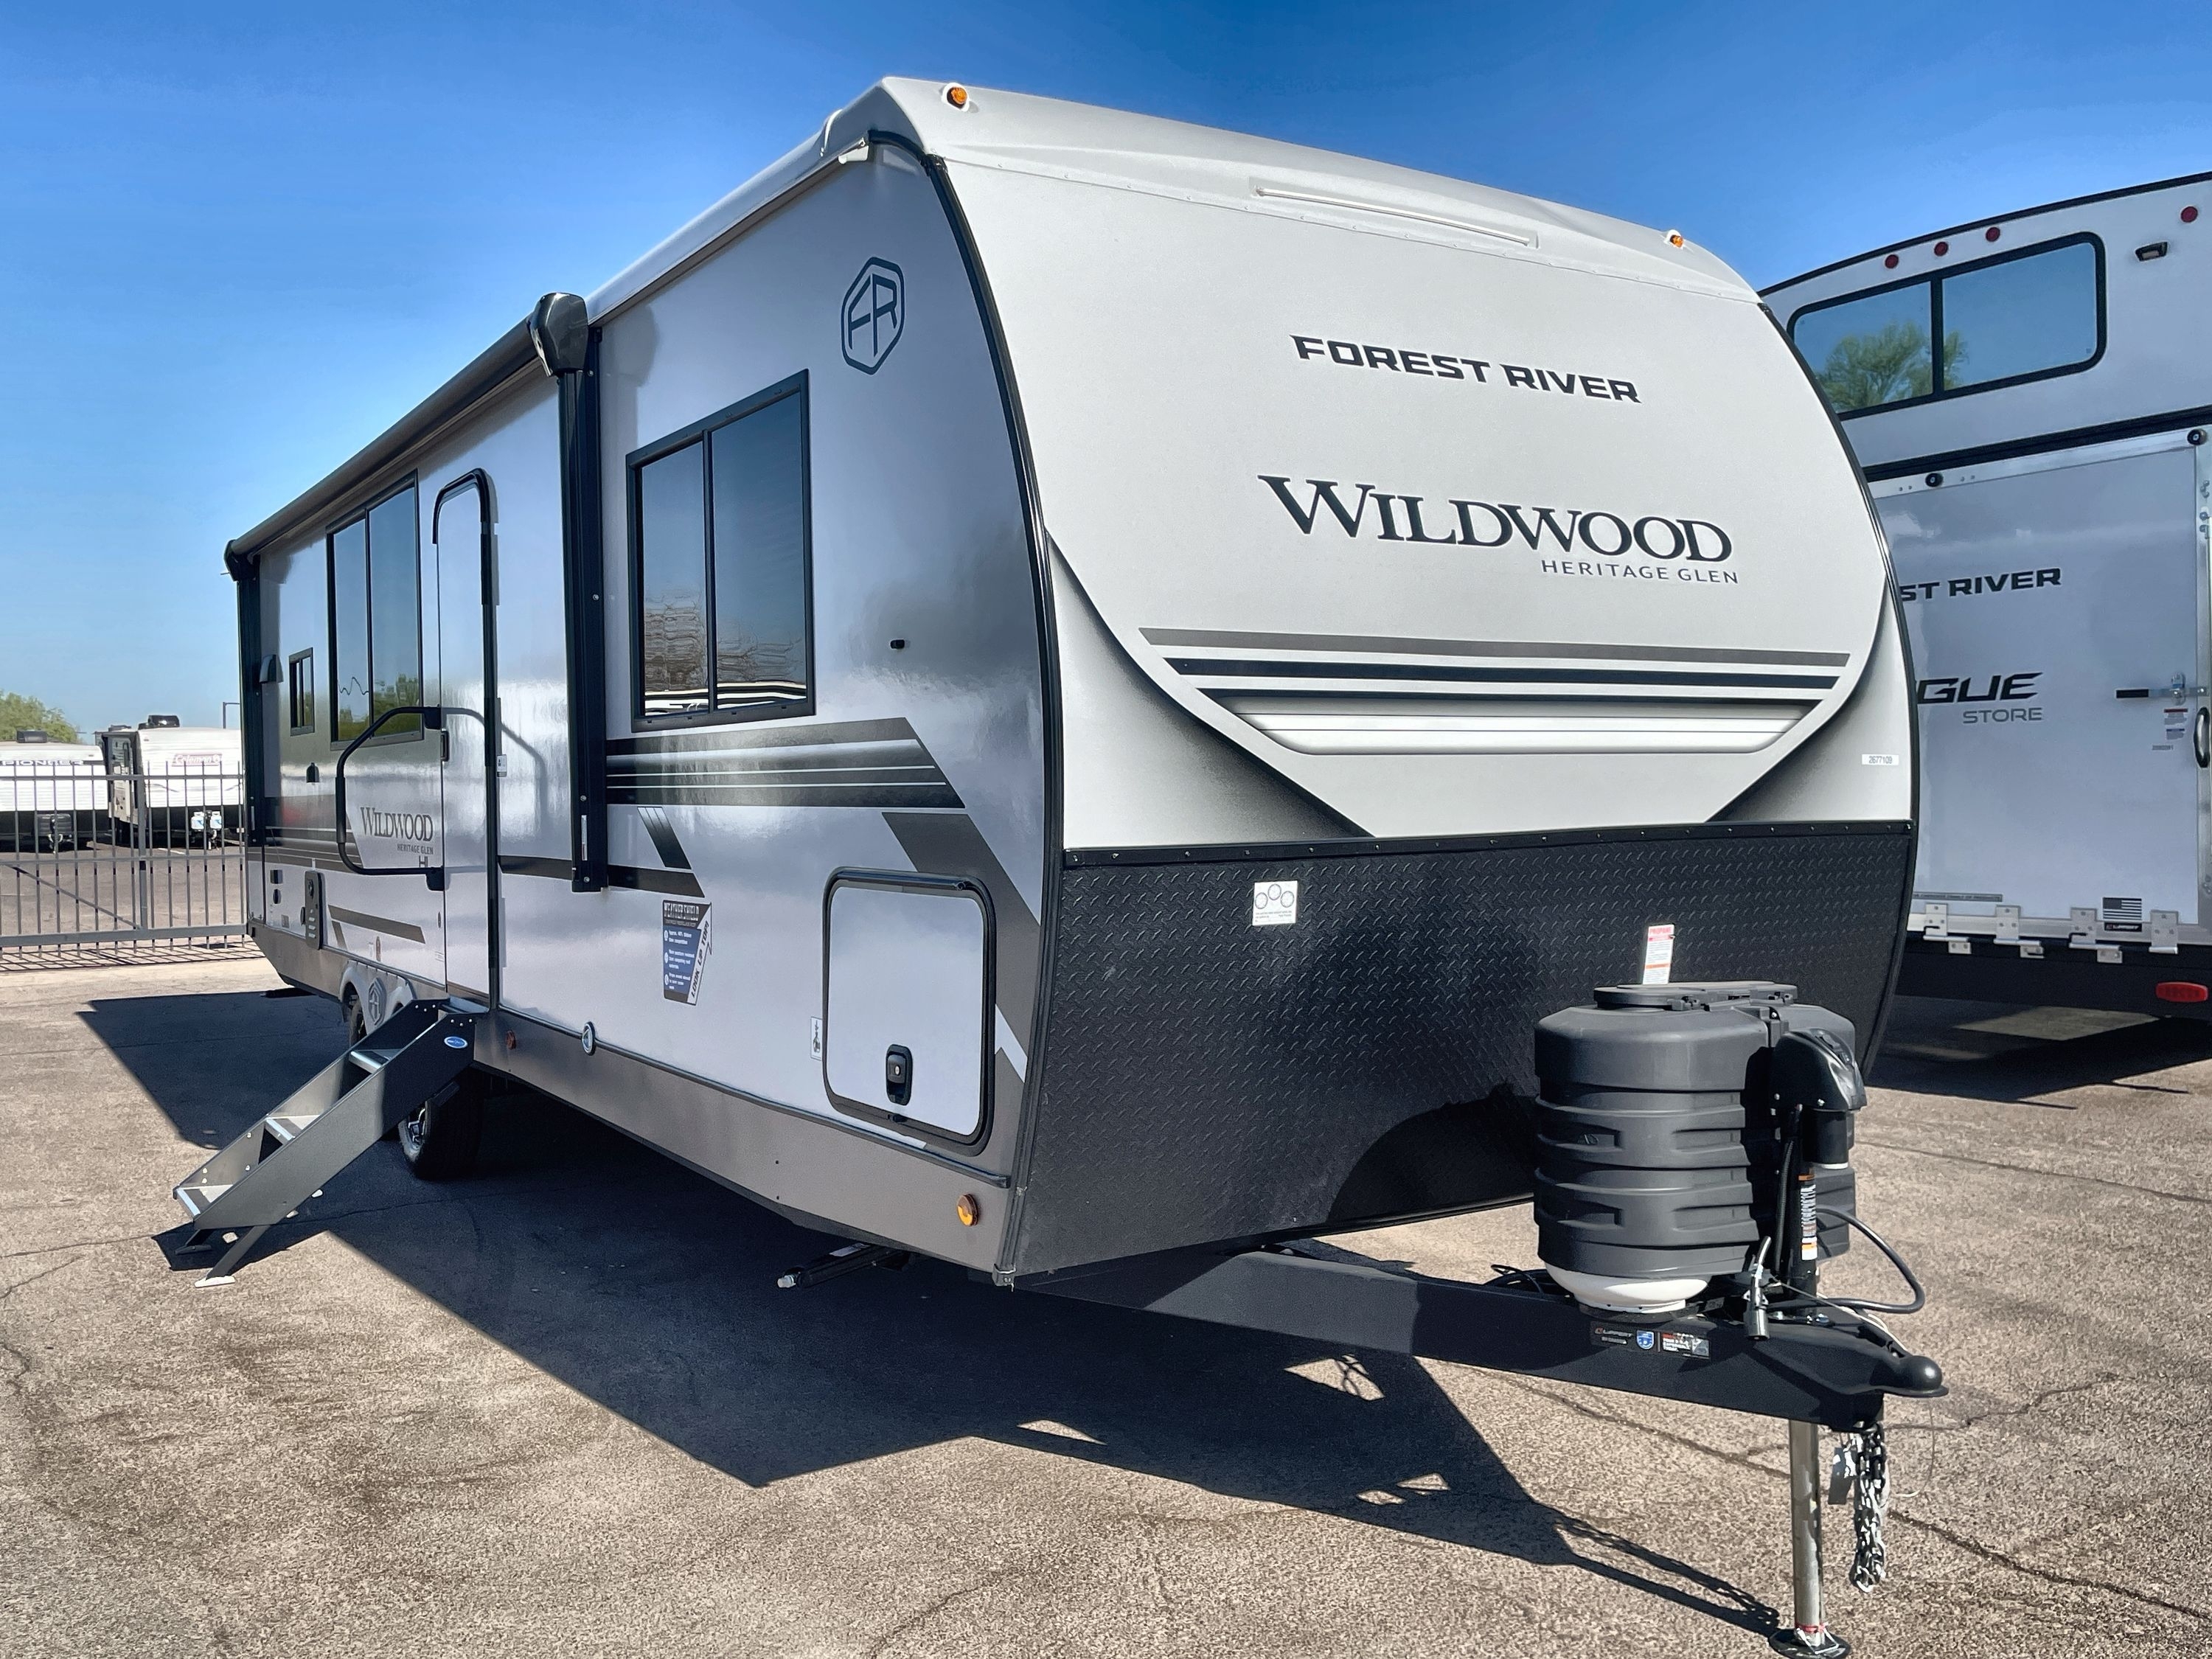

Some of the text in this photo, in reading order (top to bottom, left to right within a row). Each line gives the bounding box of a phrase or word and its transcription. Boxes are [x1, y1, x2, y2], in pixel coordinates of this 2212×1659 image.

[1288, 334, 1643, 404] FOREST RIVER
[1256, 474, 1733, 563] WILDWOOD
[1541, 559, 1739, 585] HERITAGE GLEN
[1947, 568, 2062, 597] RIVER
[1917, 672, 2043, 704] GUE
[1962, 707, 2043, 724] STORE
[360, 807, 434, 842] WILDWOOD
[420, 845, 434, 855] GLEN
